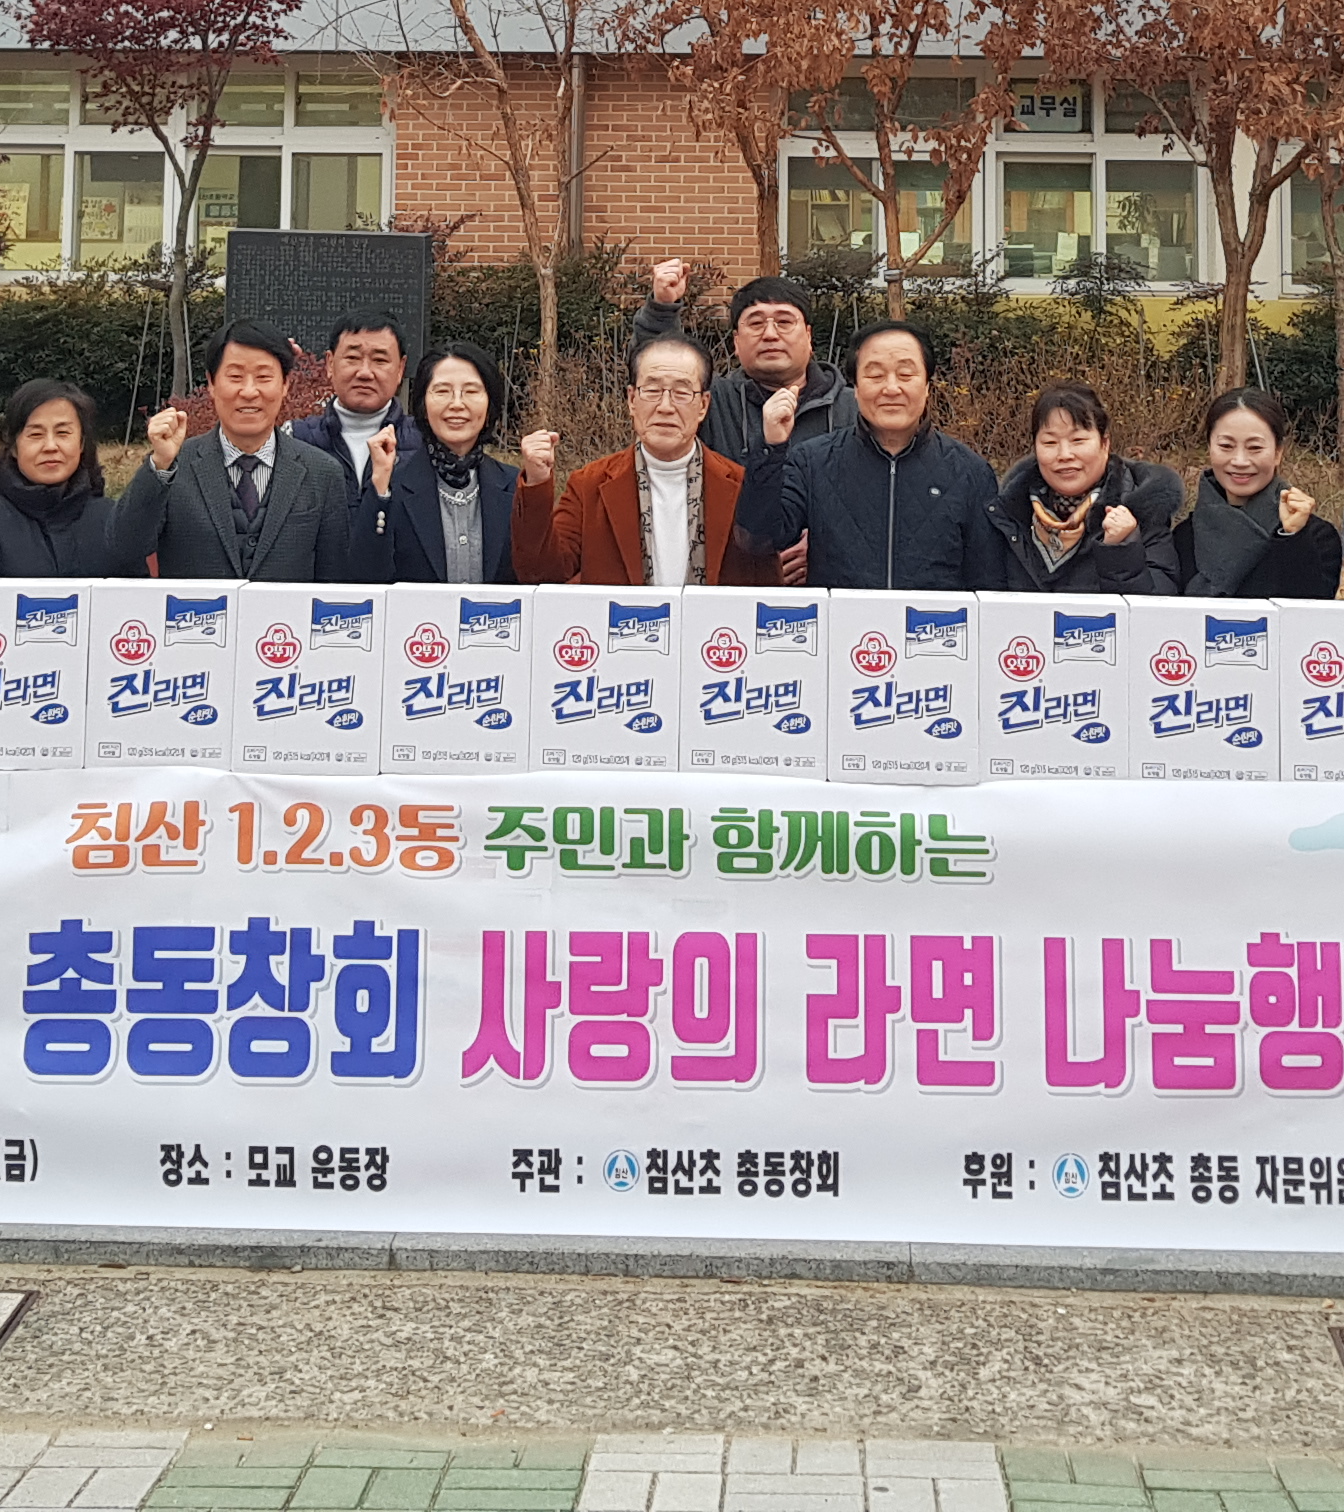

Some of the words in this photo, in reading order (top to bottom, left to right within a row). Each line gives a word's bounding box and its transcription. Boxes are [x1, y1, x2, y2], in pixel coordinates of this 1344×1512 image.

[1020, 95, 1077, 118] 교무실
[117, 641, 149, 655] 오뚜기
[263, 644, 294, 659] 오뚜기
[411, 644, 443, 658] 오뚜기
[560, 647, 592, 662] 오뚜기
[708, 648, 740, 663] 오뚜기
[858, 652, 889, 667] 오뚜기
[1006, 657, 1037, 672] 오뚜기
[1157, 661, 1189, 676] 오뚜기
[1308, 662, 1340, 677] 오뚜기
[108, 668, 210, 718] 진라면
[253, 672, 355, 722] 진라면
[402, 671, 504, 721] 진라면
[552, 675, 654, 725] 진라면
[700, 676, 802, 726] 진라면
[849, 681, 953, 731] 진라면
[997, 685, 1101, 735] 진라면
[1149, 689, 1253, 739] 진라면
[67, 801, 205, 870] 침산
[229, 802, 459, 872] 1.2.3동
[487, 807, 688, 873] 주민과
[713, 808, 986, 876] 함께하는
[23, 916, 420, 1079] 총동창회
[461, 930, 758, 1083] 사랑의
[806, 933, 996, 1087] 라면
[160, 1143, 210, 1187] 장소
[248, 1145, 297, 1188] 모교
[311, 1144, 390, 1192] 운동장
[511, 1148, 562, 1193] 주관
[645, 1147, 721, 1195] 침산초
[736, 1149, 841, 1198] 총동창회
[963, 1151, 1014, 1199] 후원
[1098, 1151, 1175, 1202] 침산초
[1190, 1152, 1240, 1204] 총동
